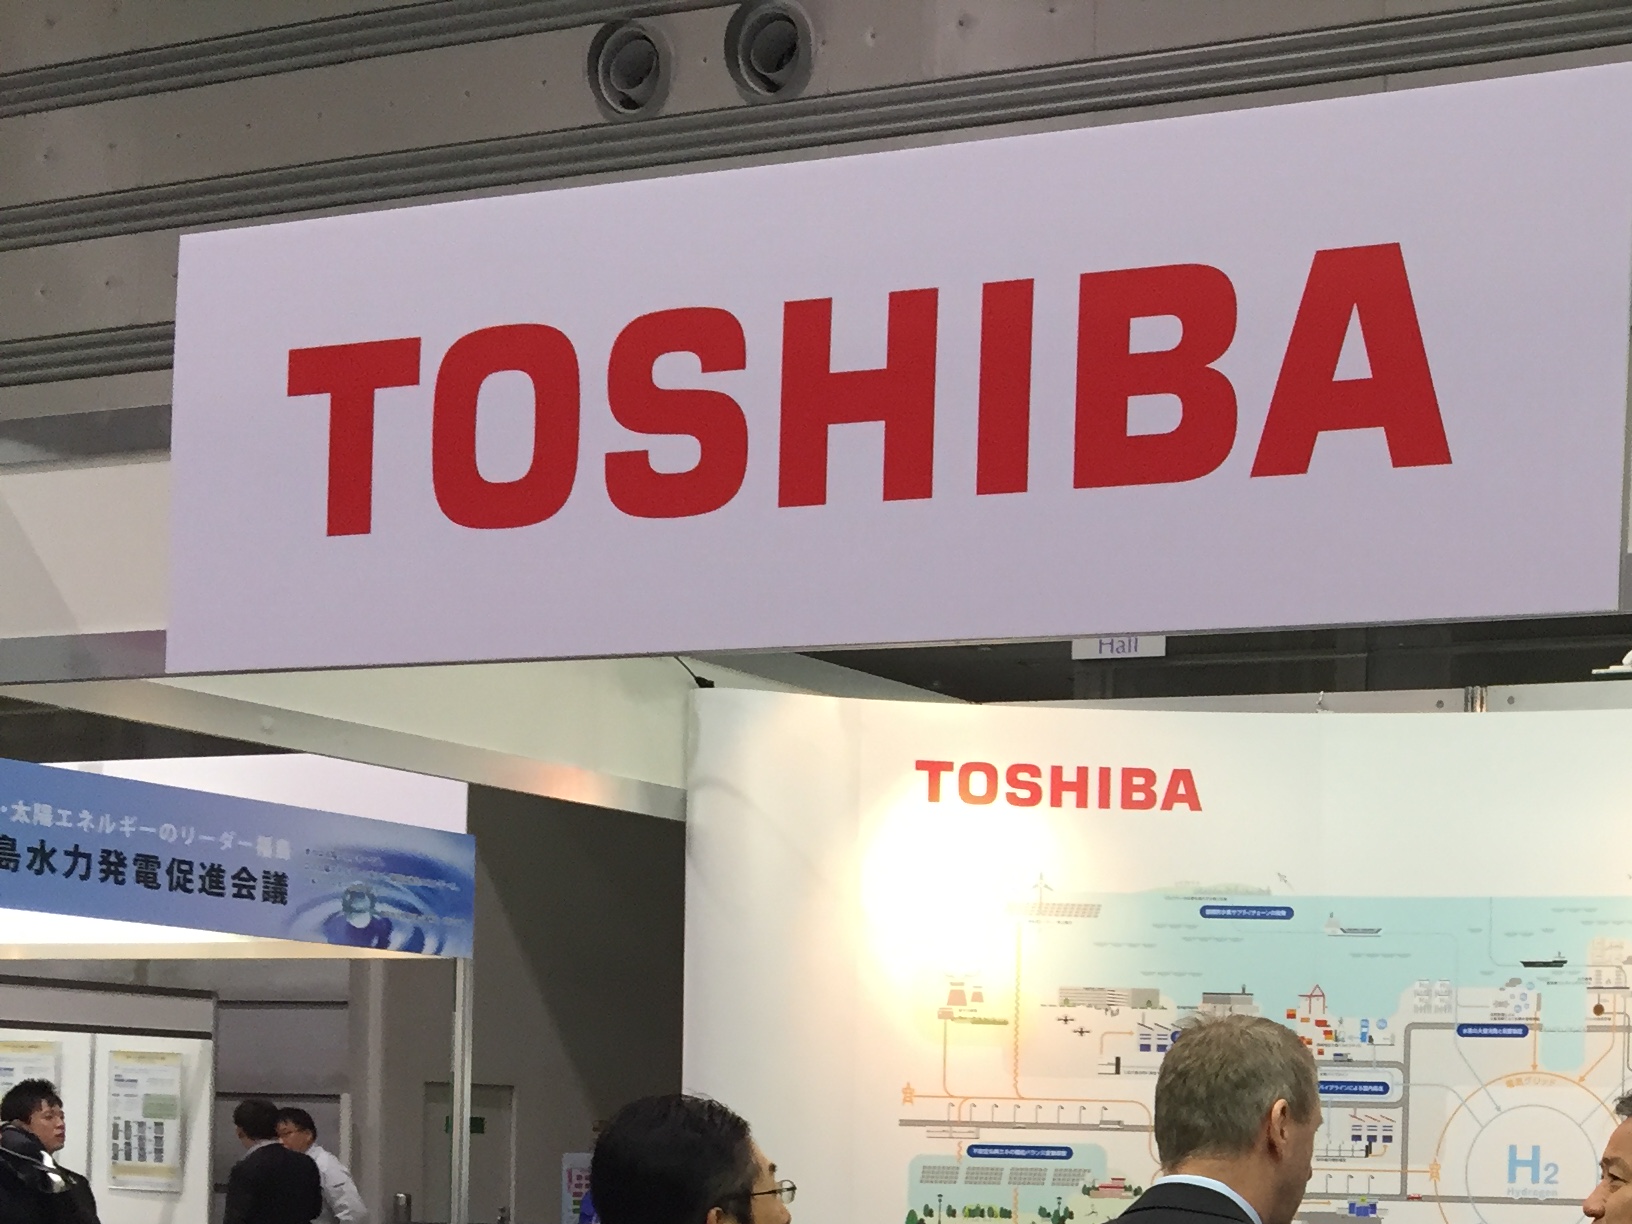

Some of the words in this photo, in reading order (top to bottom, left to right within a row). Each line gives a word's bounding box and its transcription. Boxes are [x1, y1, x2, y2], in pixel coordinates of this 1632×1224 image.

[287, 243, 1452, 536] TOSHIBA
[1098, 636, 1138, 654] Hall
[915, 760, 1202, 811] TOSHIBA
[1507, 1145, 1559, 1184] H2
